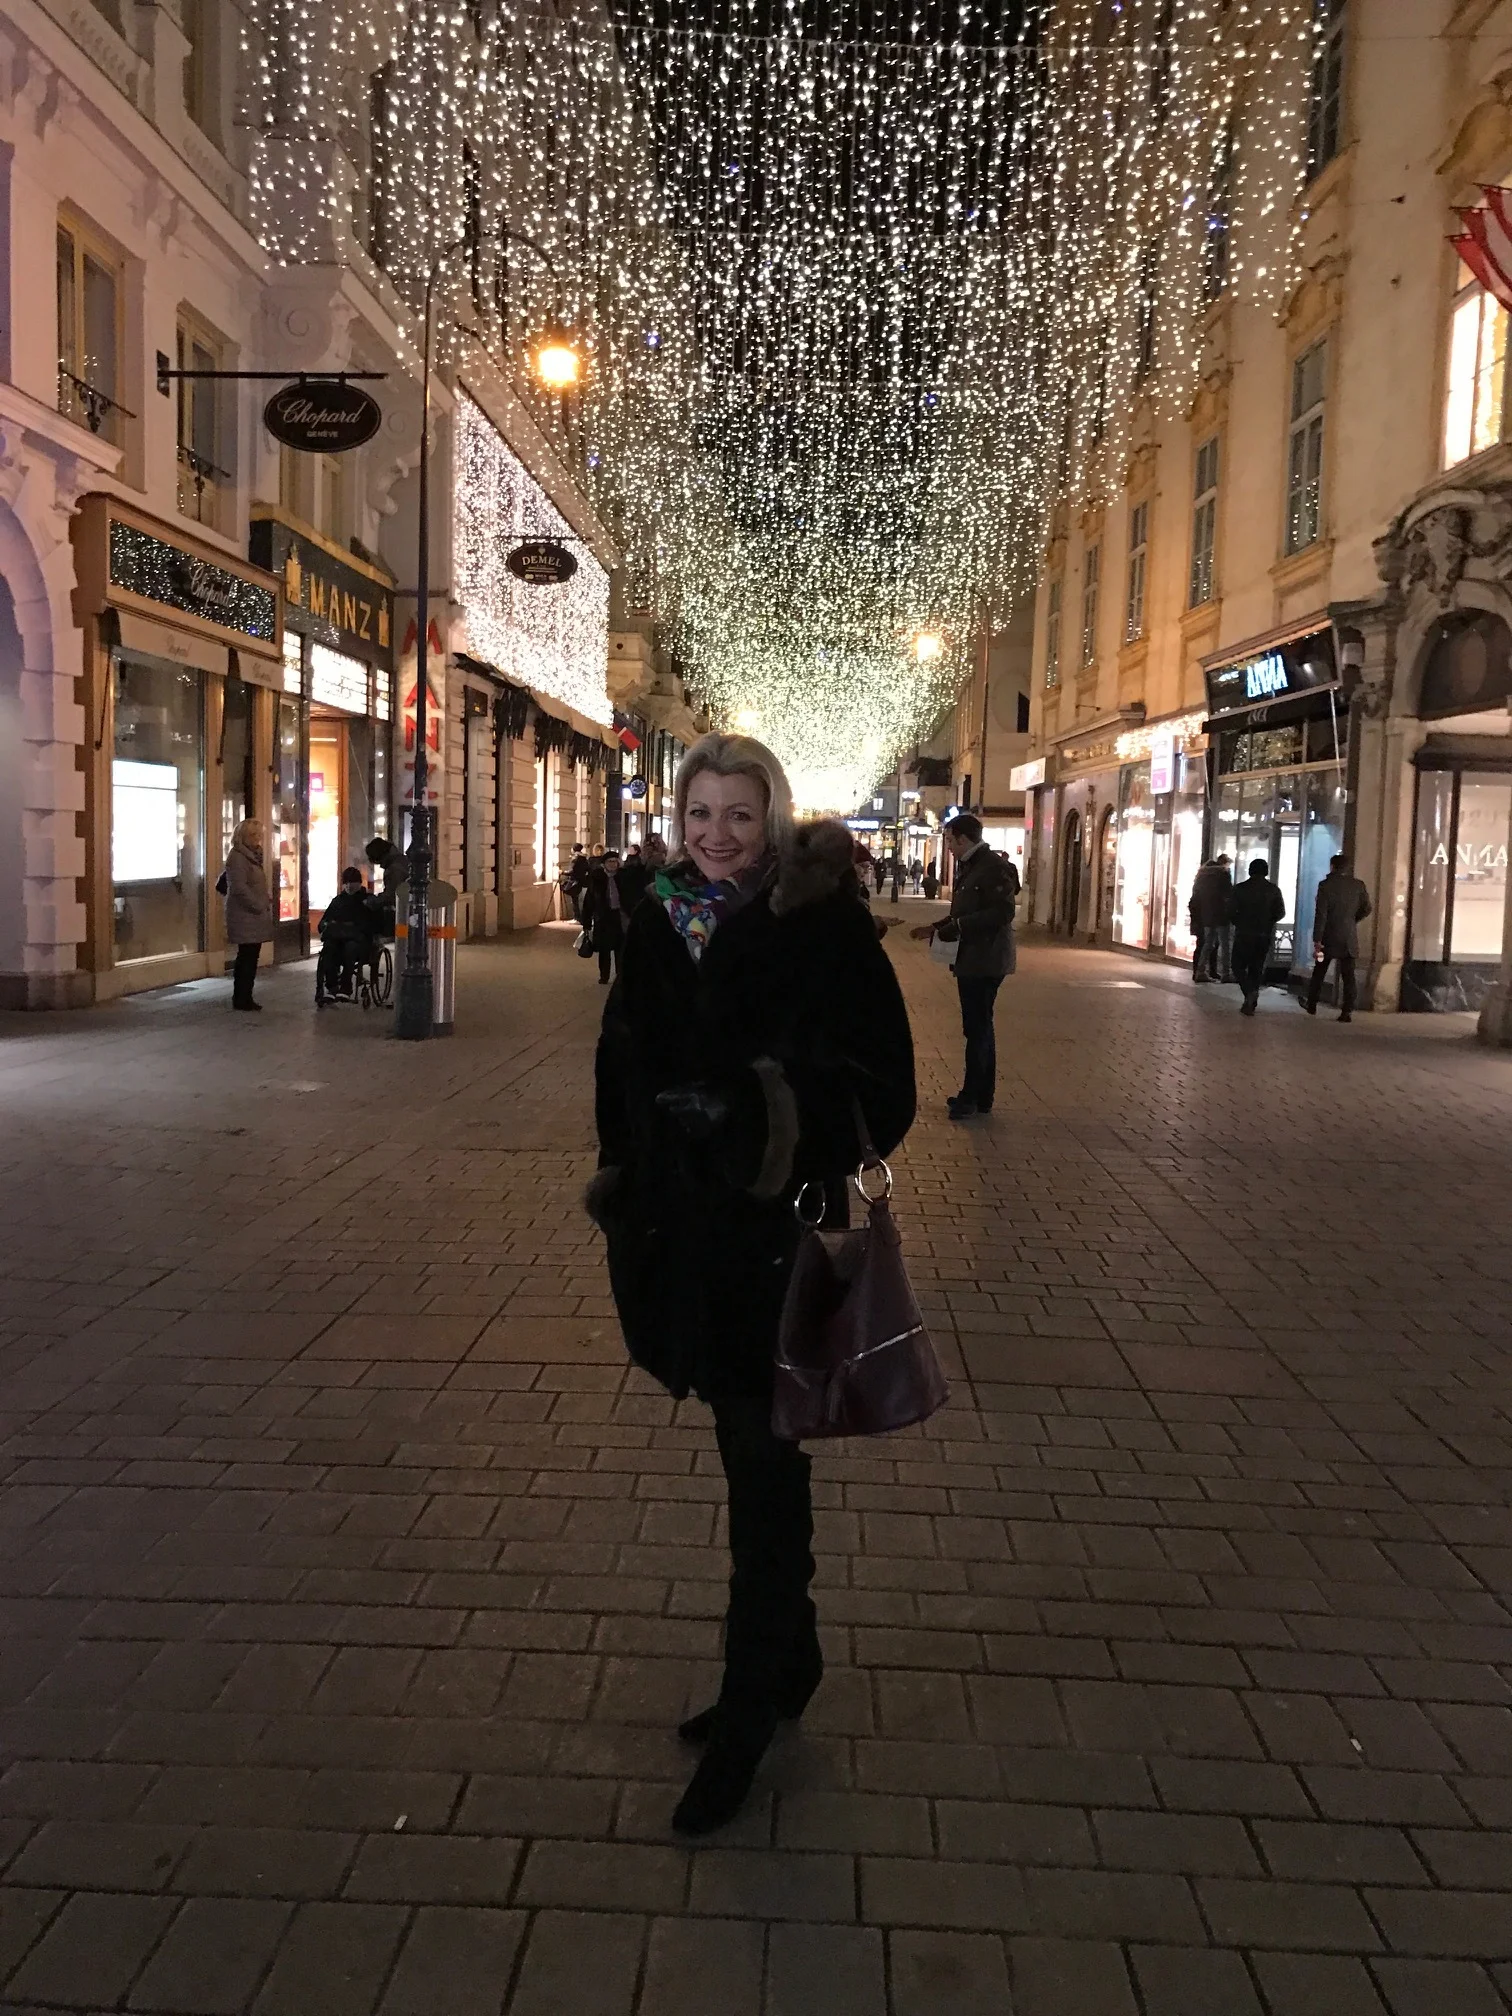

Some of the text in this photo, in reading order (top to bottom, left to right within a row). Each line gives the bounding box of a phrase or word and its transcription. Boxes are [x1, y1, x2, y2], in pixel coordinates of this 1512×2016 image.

[277, 399, 367, 428] Chopard
[522, 555, 562, 567] DEMEL
[310, 573, 371, 641] MANZ
